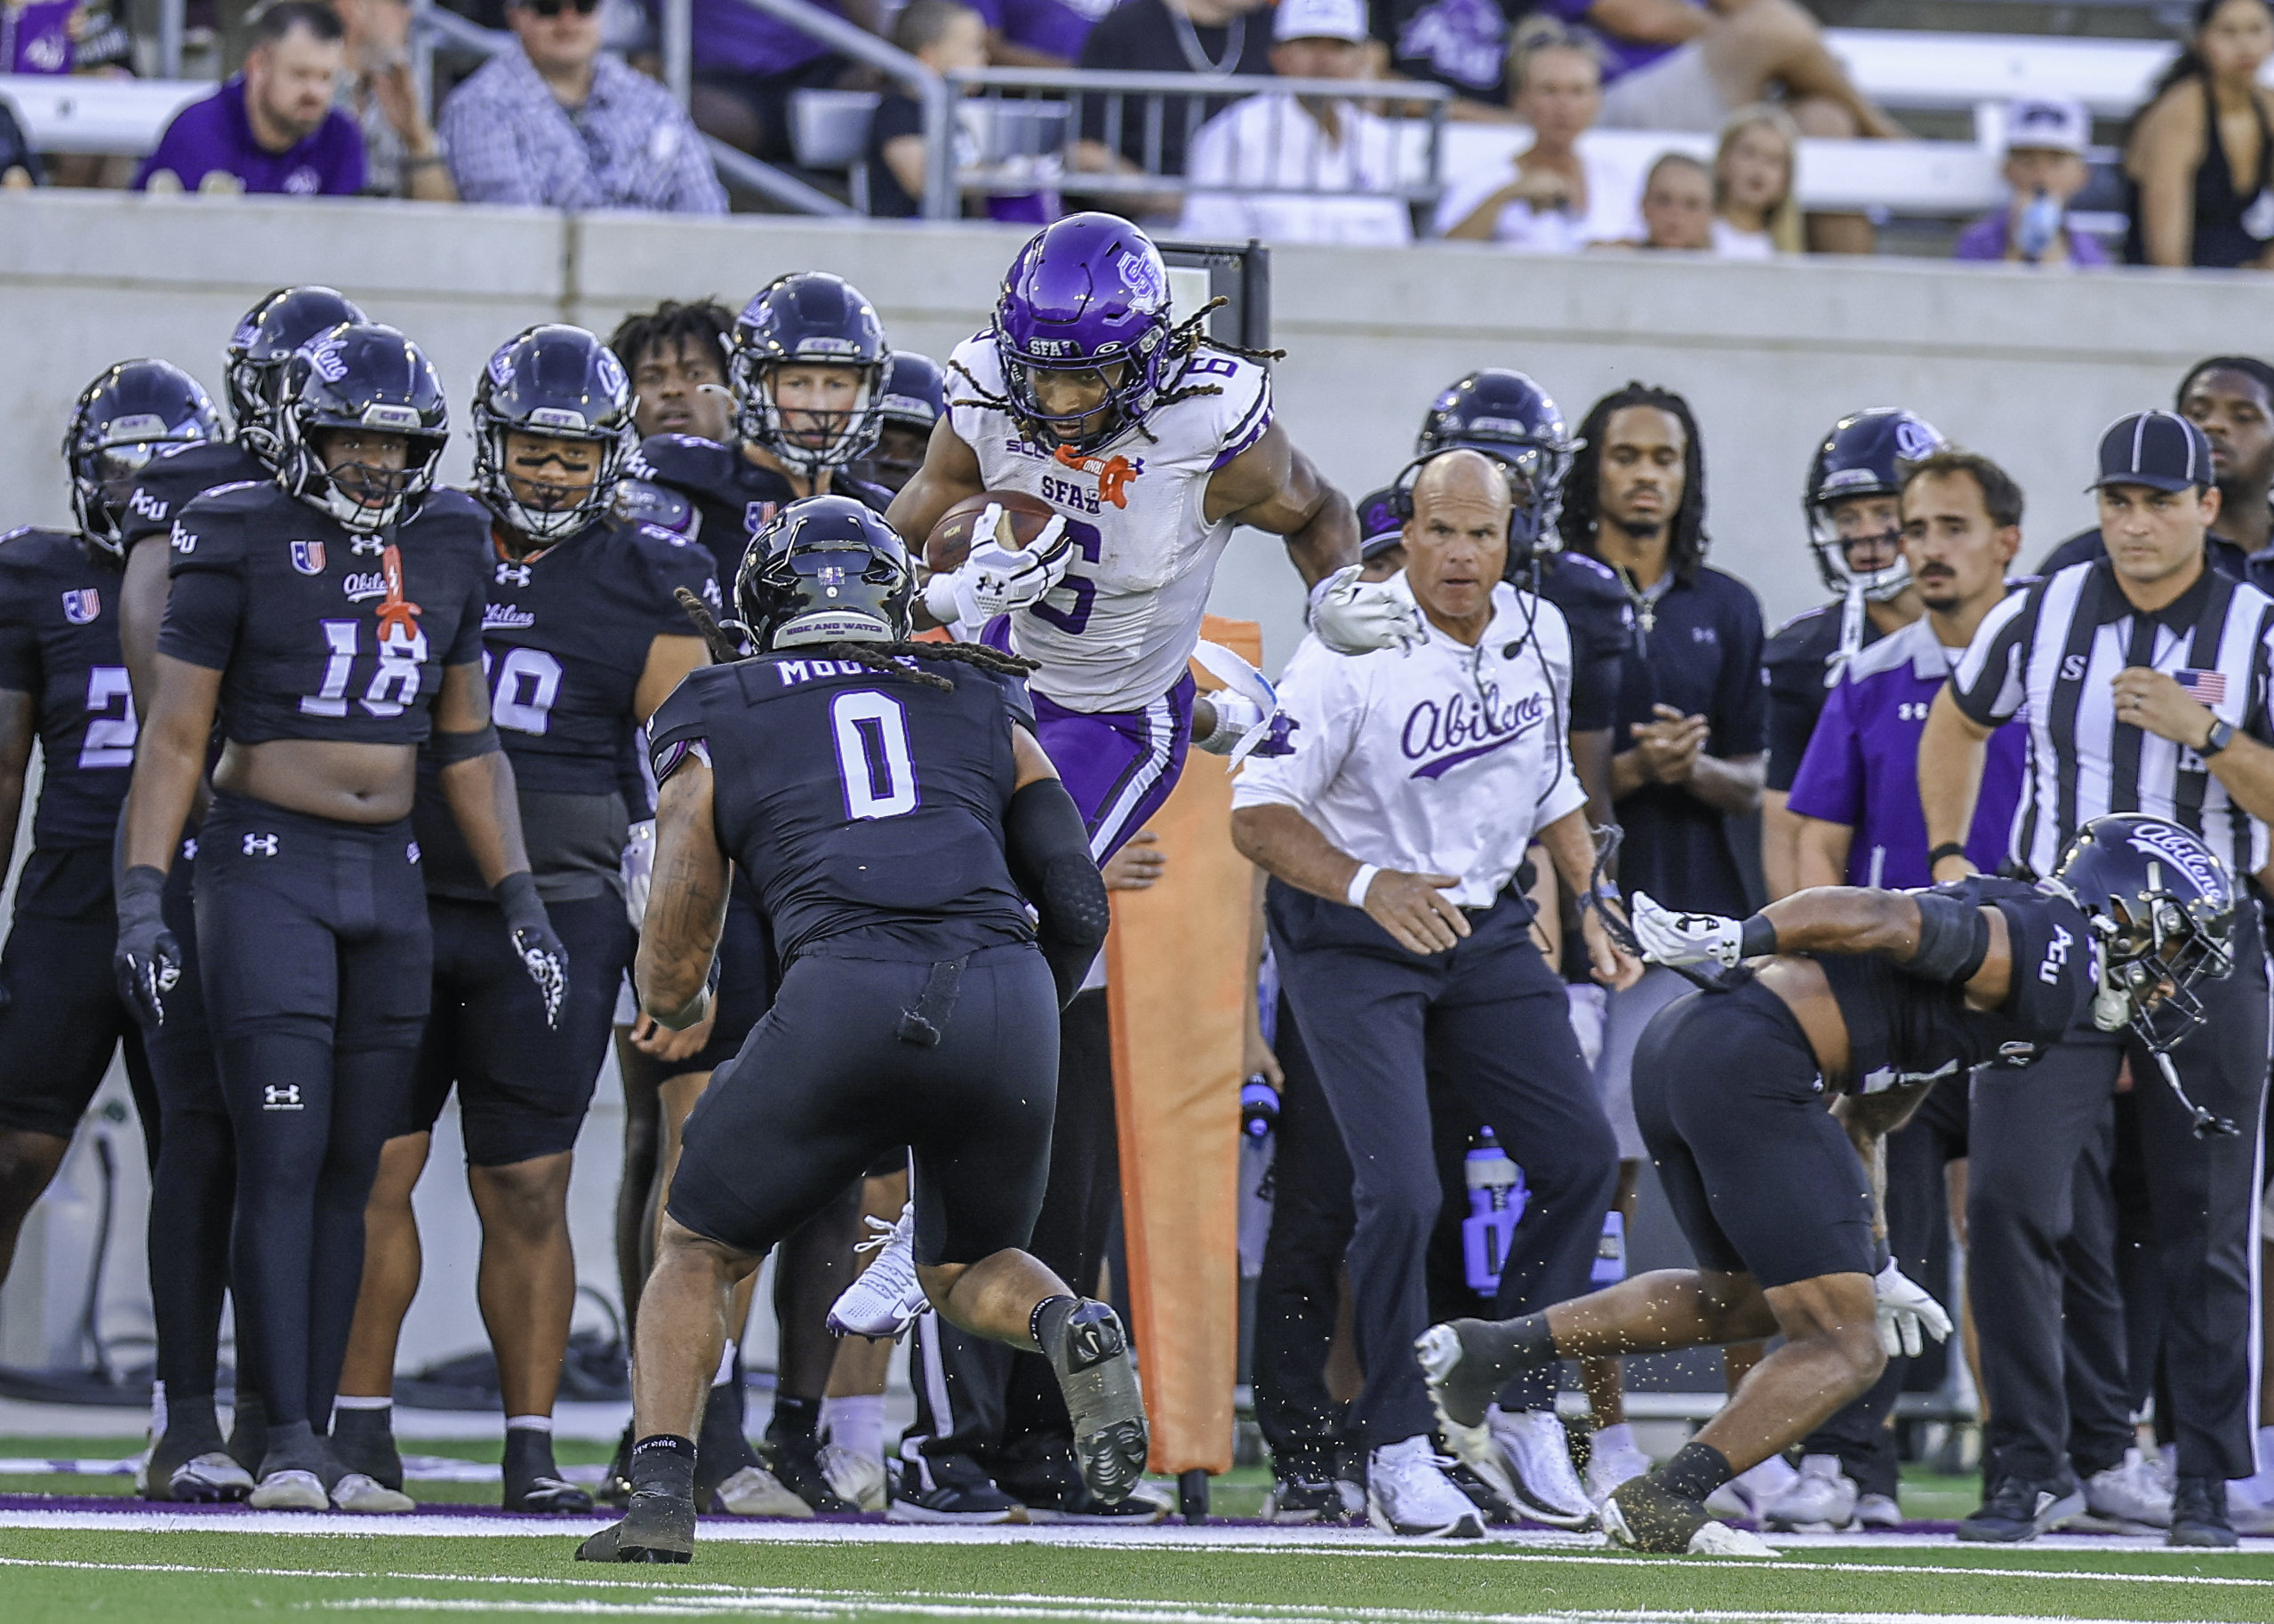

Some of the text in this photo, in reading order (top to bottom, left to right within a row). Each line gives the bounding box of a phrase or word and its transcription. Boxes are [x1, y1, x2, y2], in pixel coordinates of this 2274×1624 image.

[1029, 340, 1063, 356] SFA
[1186, 357, 1239, 378] 6
[129, 486, 170, 521] ACU
[1042, 475, 1084, 510] SFA
[813, 622, 840, 631] AND
[843, 622, 883, 634] WATCH
[299, 618, 429, 719] 18
[2059, 654, 2087, 682] S
[829, 688, 921, 820] 0
[2038, 924, 2074, 986] ACU
